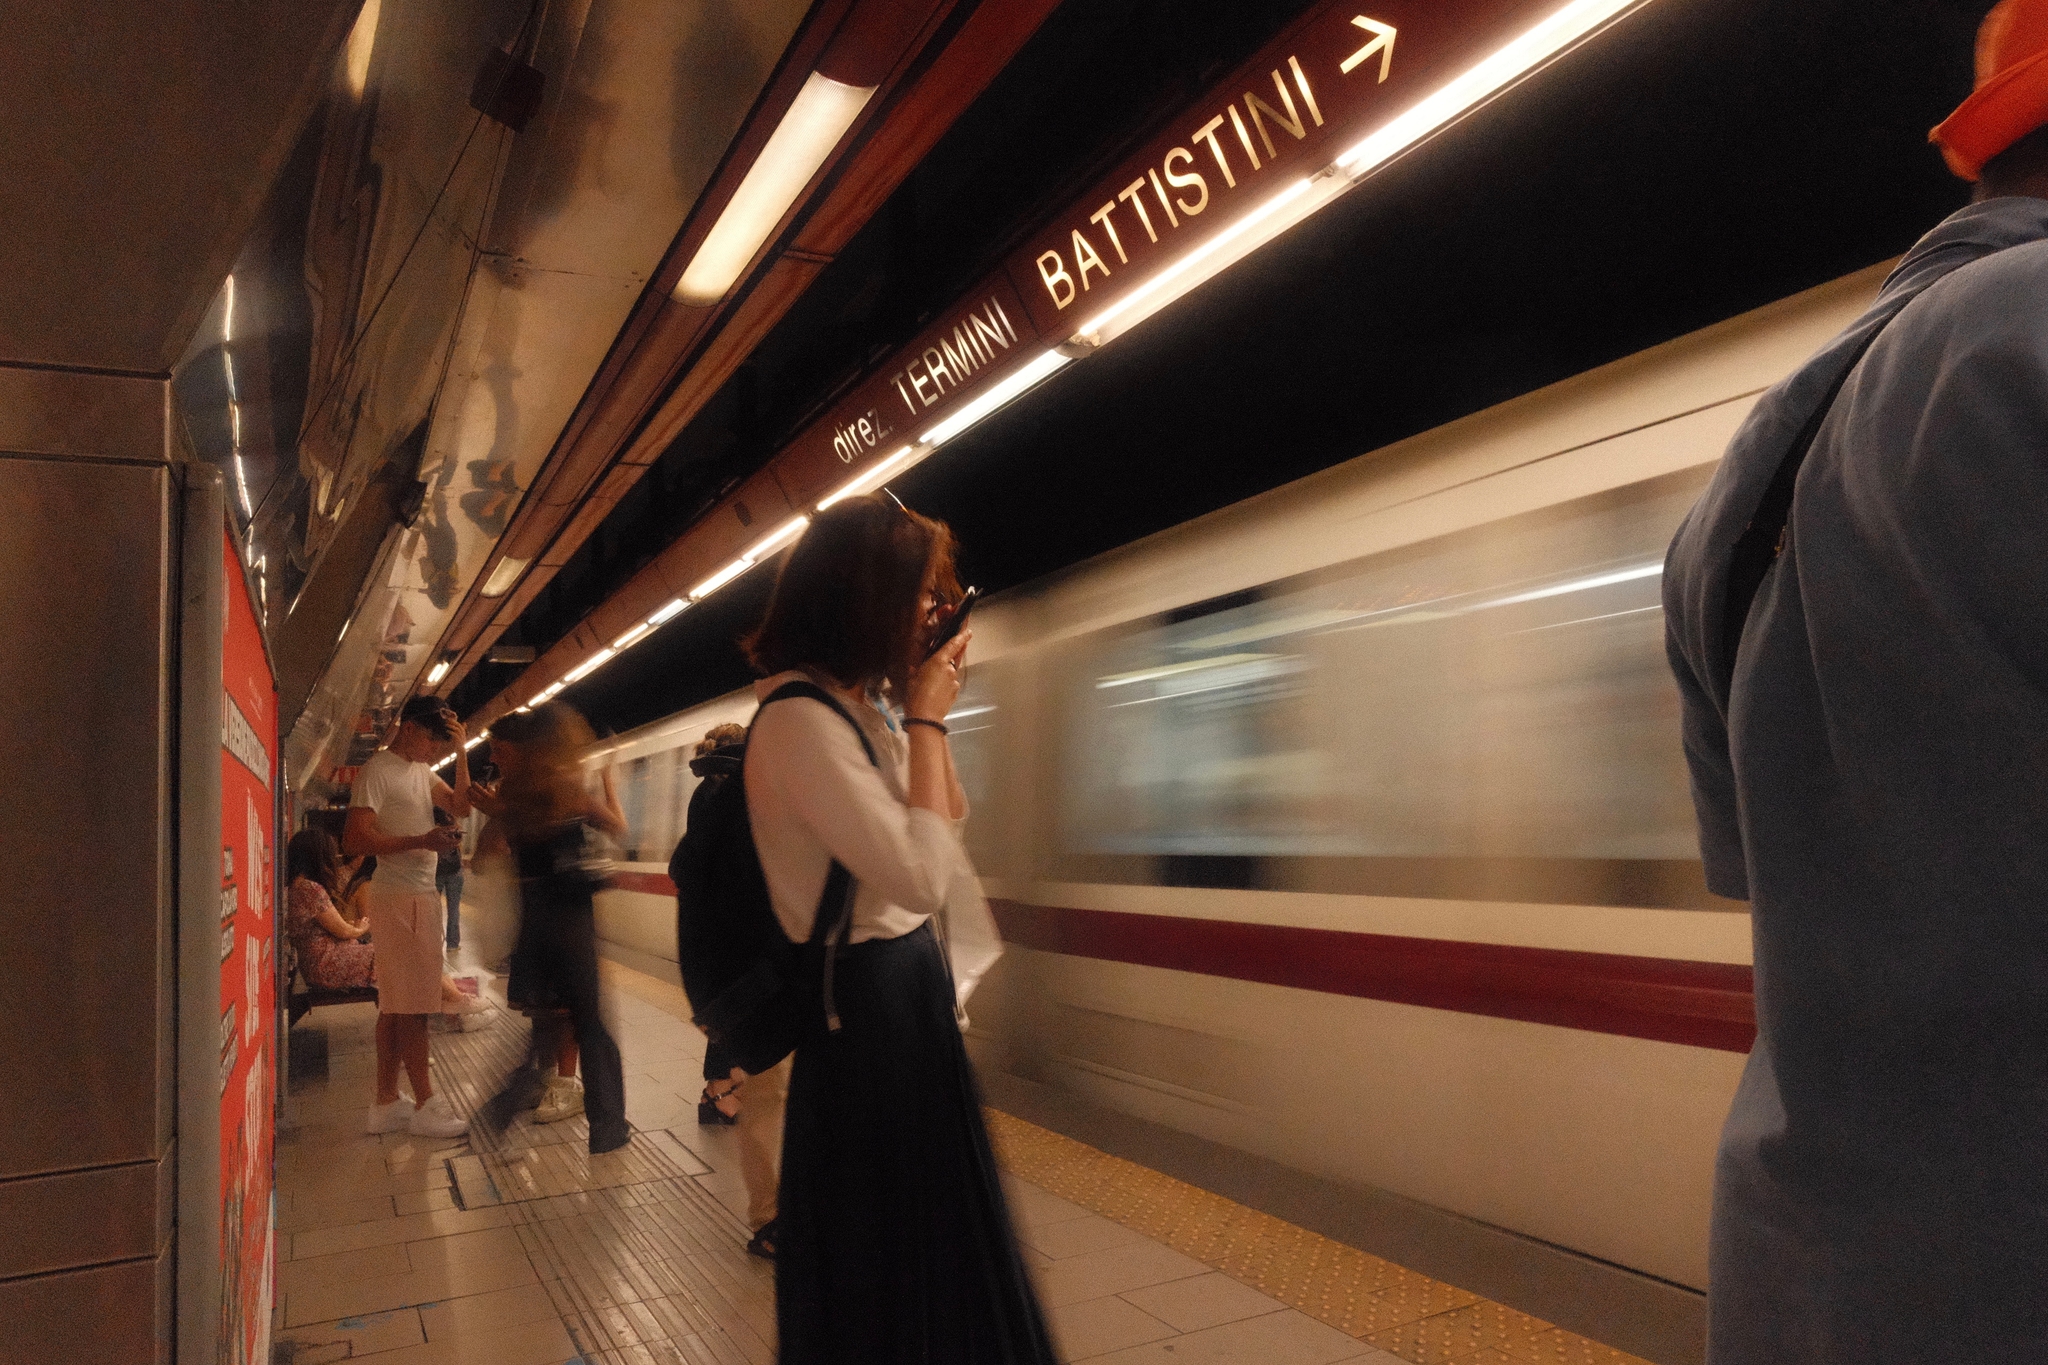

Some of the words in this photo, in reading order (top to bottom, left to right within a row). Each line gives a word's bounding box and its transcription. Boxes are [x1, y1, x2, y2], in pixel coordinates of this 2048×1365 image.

[833, 408, 894, 464] direz.
[889, 295, 1018, 416] TERMINI
[1036, 55, 1324, 311] BATTISTINI
